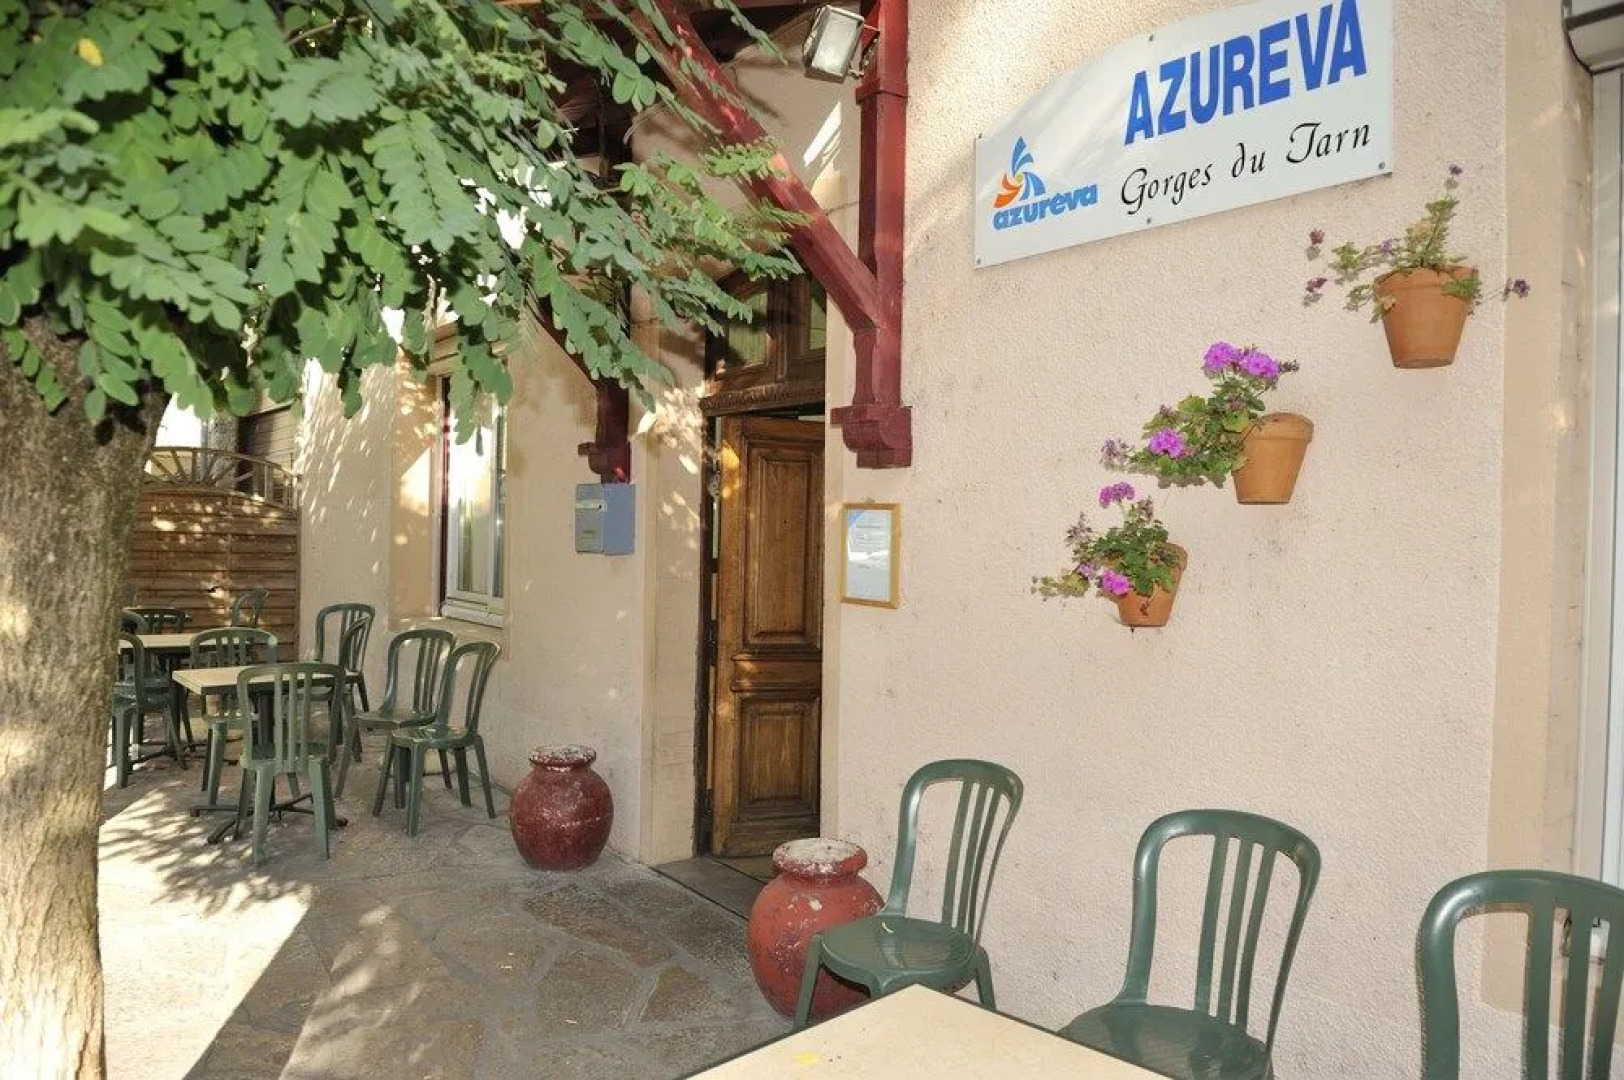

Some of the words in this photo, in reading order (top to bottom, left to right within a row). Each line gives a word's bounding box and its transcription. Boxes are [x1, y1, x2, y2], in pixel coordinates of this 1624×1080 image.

[1124, 0, 1367, 145] AZUREVA
[1121, 162, 1212, 215] Gorges
[1231, 142, 1266, 179] du
[1286, 121, 1370, 164] Tarn
